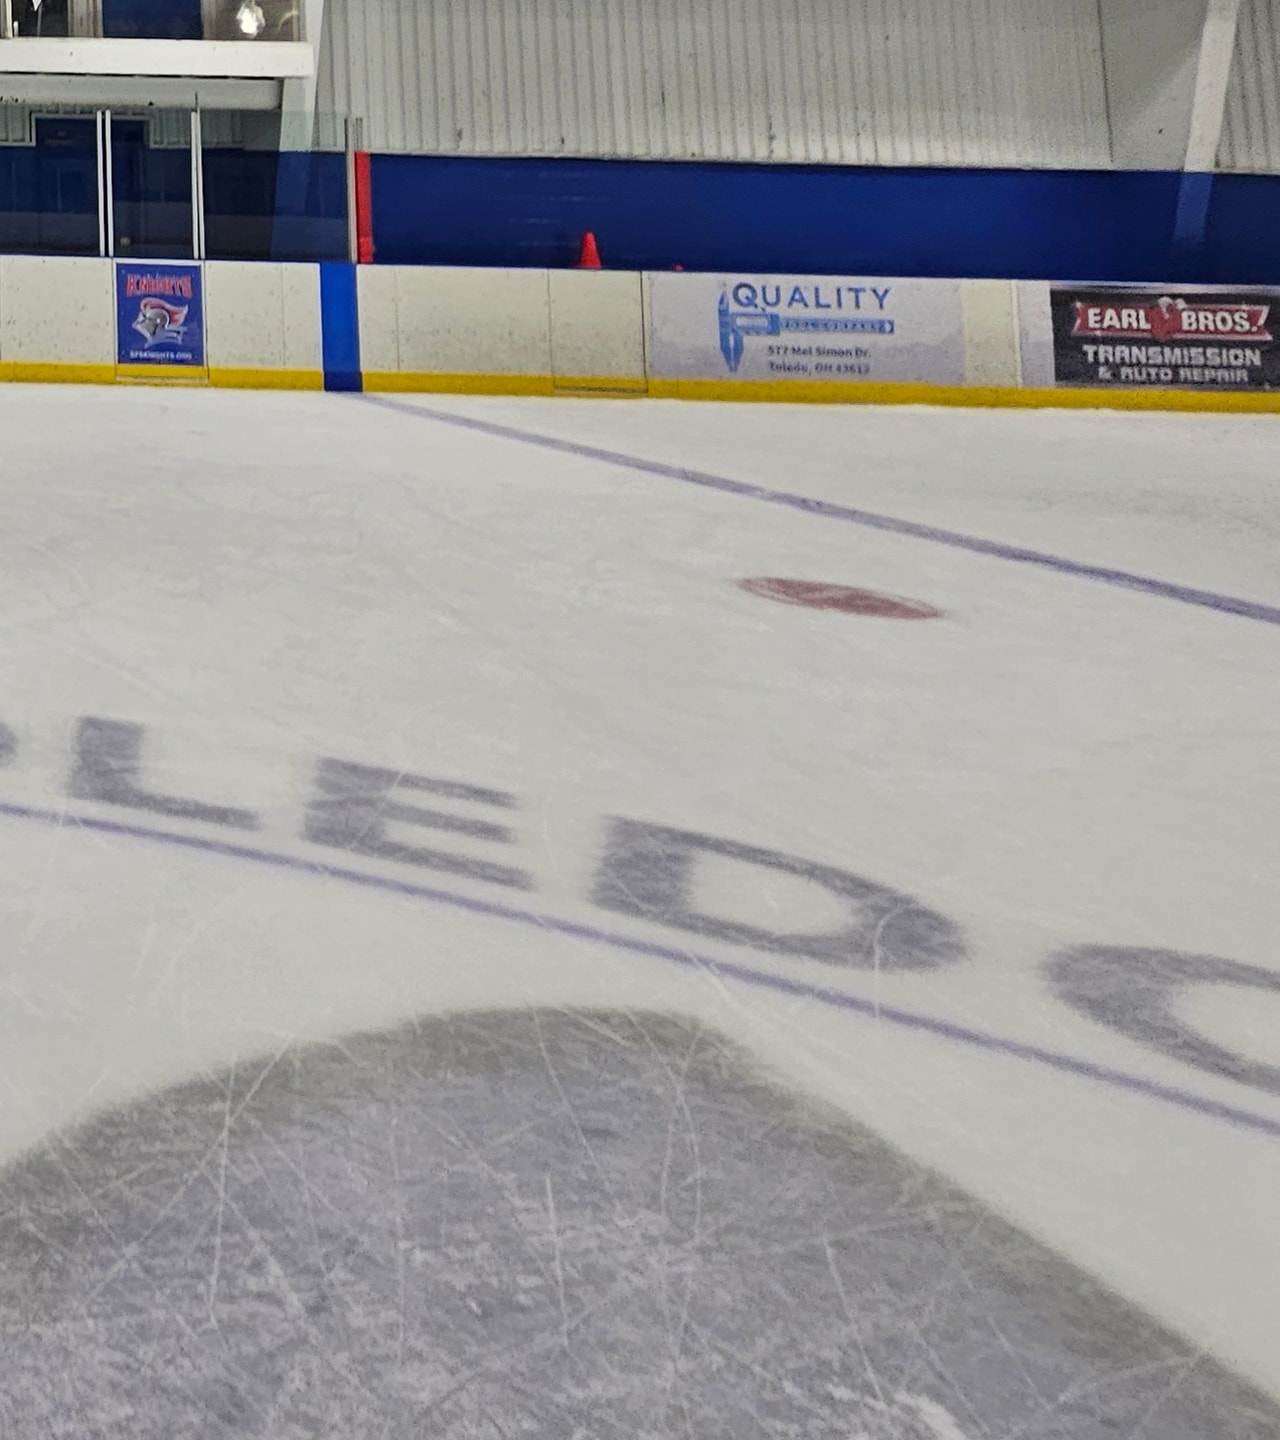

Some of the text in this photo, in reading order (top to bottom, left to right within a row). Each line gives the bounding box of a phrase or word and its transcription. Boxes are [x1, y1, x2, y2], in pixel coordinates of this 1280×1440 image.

[732, 282, 892, 312] QUALITY
[1087, 308, 1152, 330] EARL
[791, 345, 812, 357] Mel
[815, 346, 853, 358] Simon
[854, 346, 872, 359] Dr.
[1081, 344, 1262, 367] TRANSMISSION
[1097, 365, 1249, 383] & AUTO REPAIR
